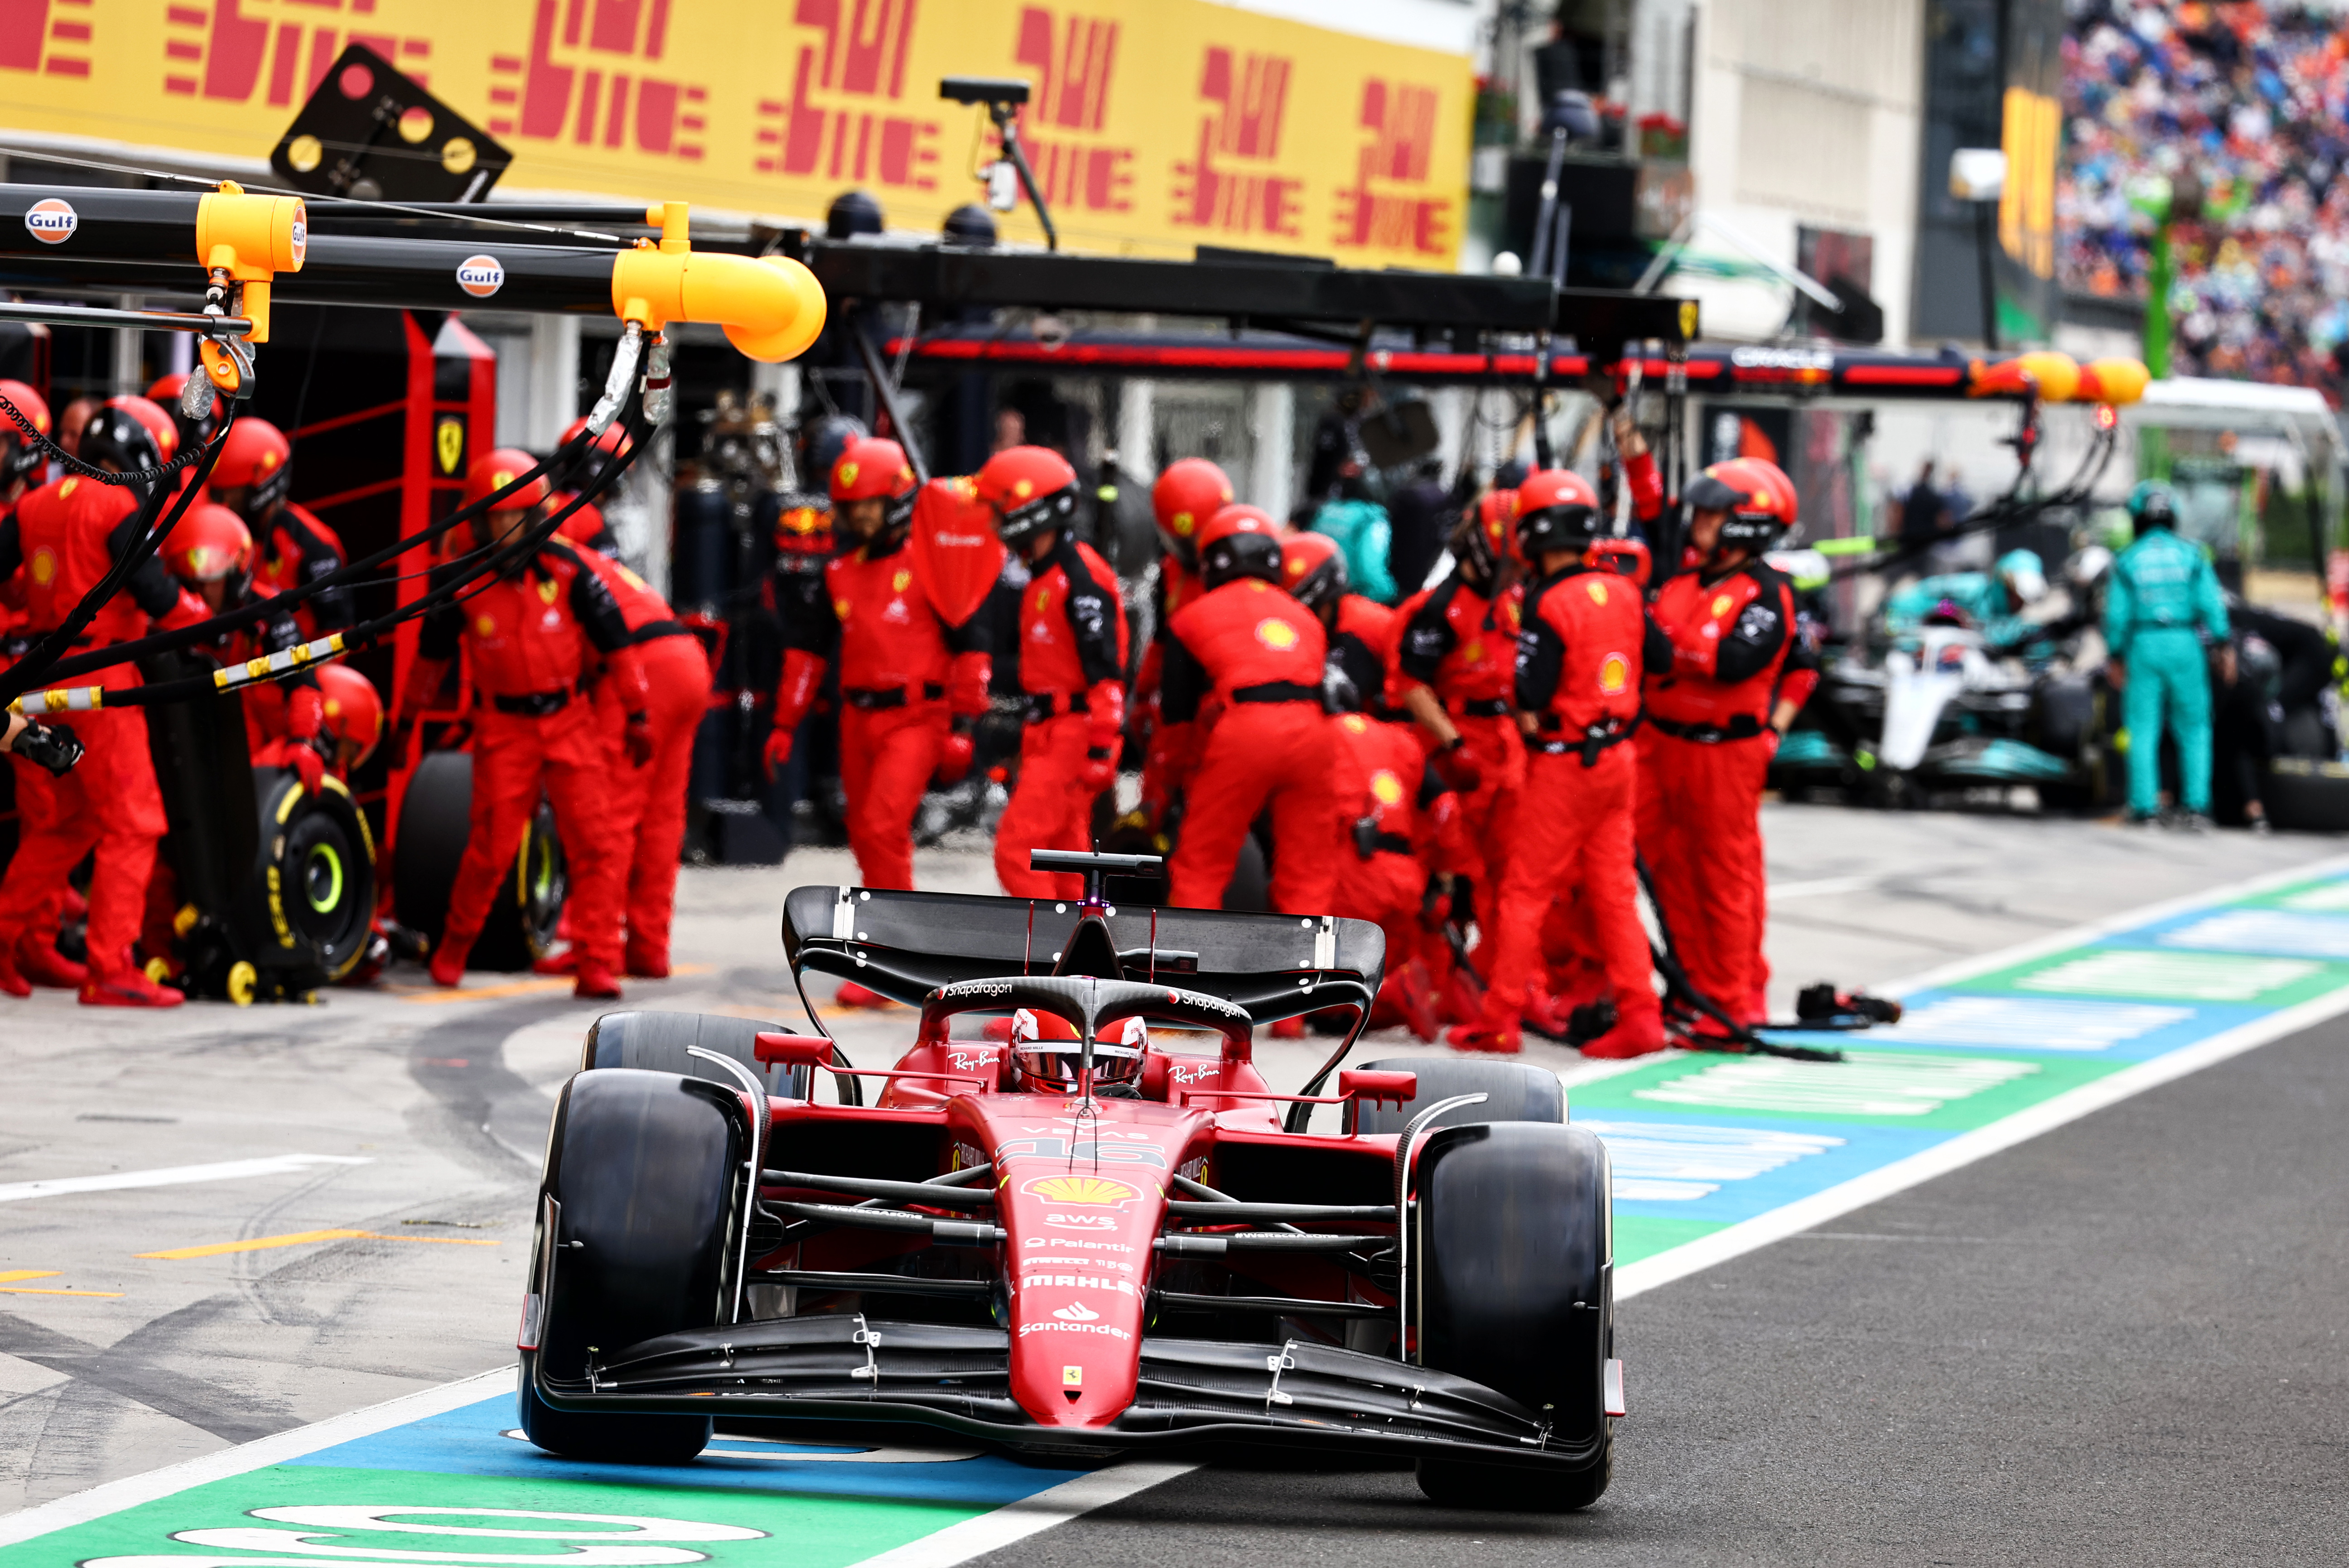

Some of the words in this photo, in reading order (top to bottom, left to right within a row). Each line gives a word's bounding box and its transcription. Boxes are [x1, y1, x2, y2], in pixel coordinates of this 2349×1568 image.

[29, 214, 73, 227] Gulf
[293, 225, 304, 242] Gulf
[460, 270, 499, 282] Gulf
[948, 982, 1012, 997] Snapdragon
[1182, 992, 1240, 1017] Snapdragon
[948, 1051, 1000, 1071] Ray-Ban
[1168, 1064, 1220, 1084] Ray-Ban
[1021, 1127, 1149, 1139] VELAS
[995, 1138, 1167, 1170] 16
[818, 1204, 922, 1219] #WeRaceAsOne
[1046, 1214, 1115, 1226] aws
[1051, 1238, 1134, 1253] Palantir
[1023, 1275, 1134, 1296] MAHLE
[1019, 1321, 1131, 1340] Santander
